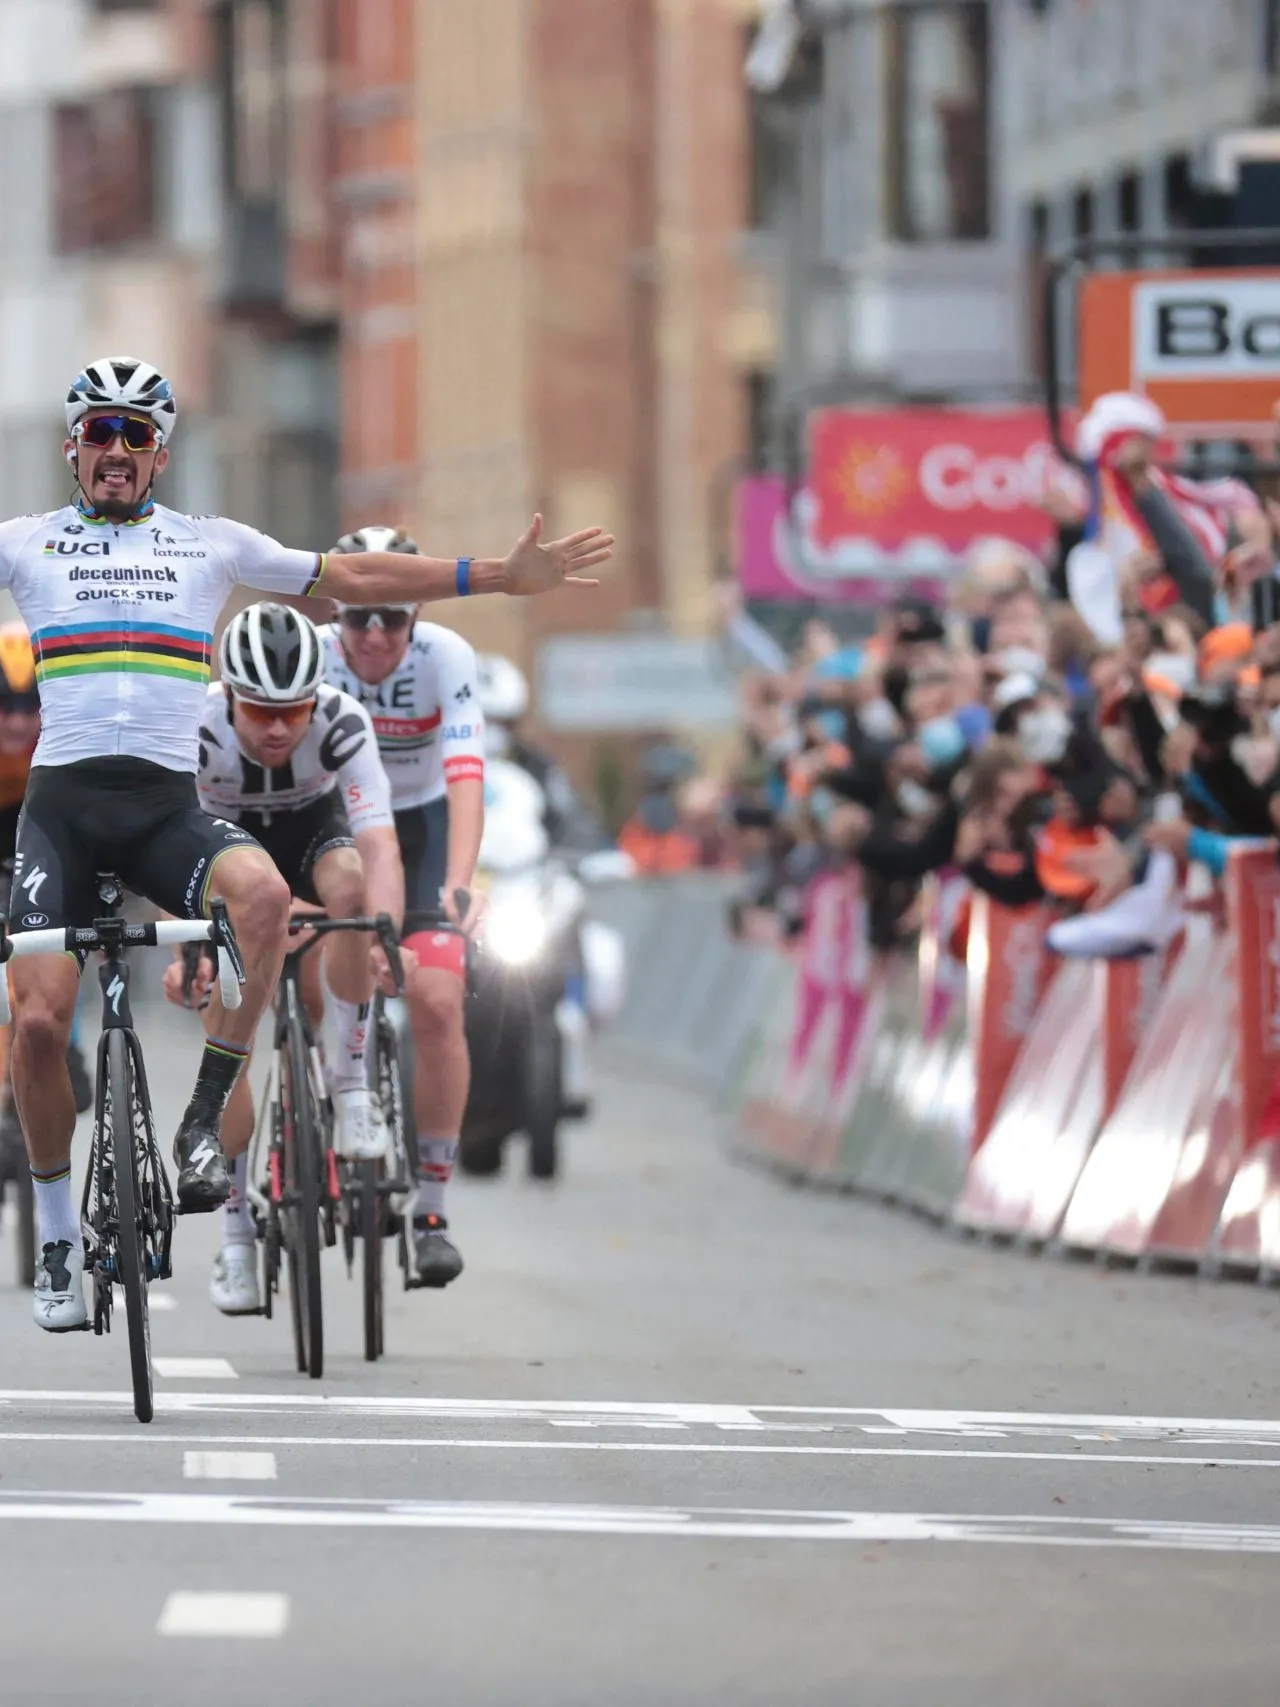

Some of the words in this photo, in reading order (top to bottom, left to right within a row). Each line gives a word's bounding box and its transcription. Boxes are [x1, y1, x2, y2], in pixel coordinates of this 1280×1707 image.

[56, 541, 110, 556] UCI
[153, 547, 206, 558] latexco
[68, 565, 179, 583] deceuninck
[76, 932, 99, 942] PRO
[124, 928, 146, 939] PRO
